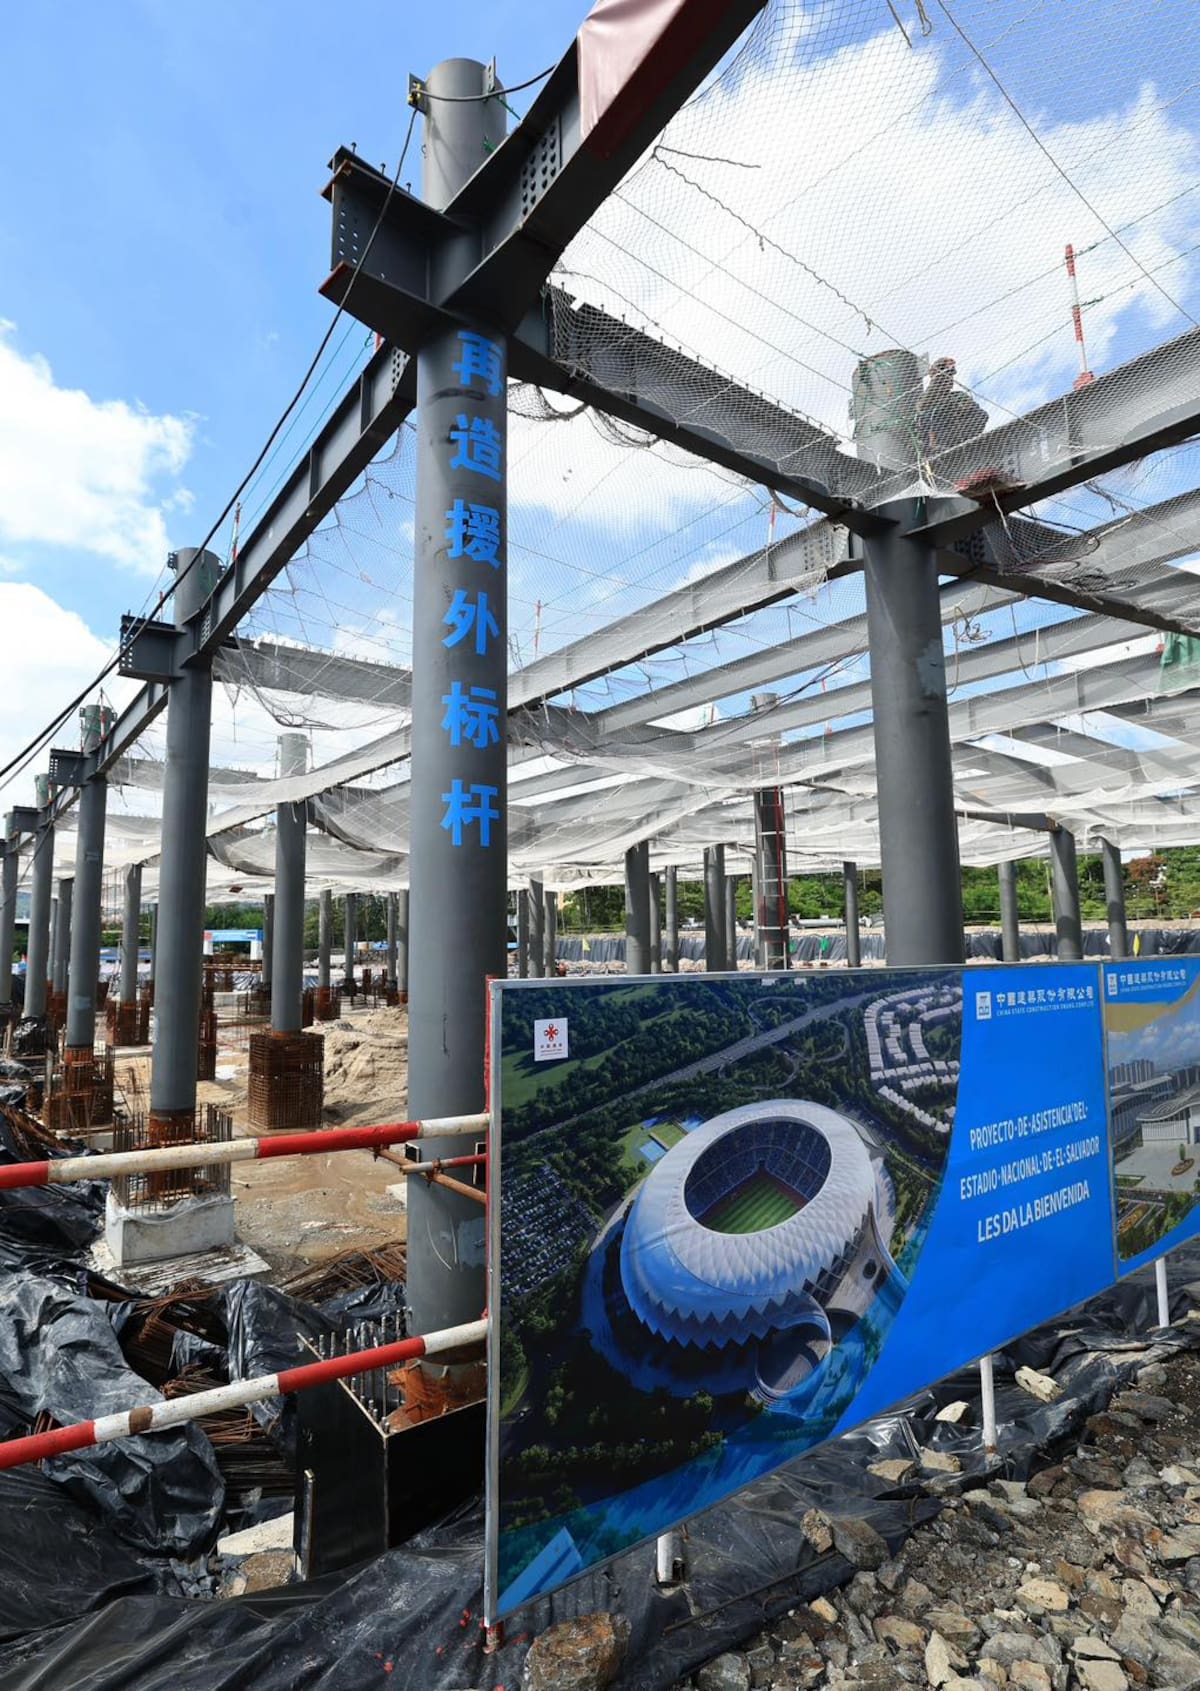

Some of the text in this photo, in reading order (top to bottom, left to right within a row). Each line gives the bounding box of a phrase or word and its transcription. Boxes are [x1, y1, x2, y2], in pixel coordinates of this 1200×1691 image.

[441, 331, 504, 847] 再造援外标杆
[970, 1120, 1014, 1151] PROYECTO
[1018, 1116, 1028, 1137] DE
[1031, 1104, 1073, 1133] ASISTENCIA
[960, 1135, 1100, 1200] ESTADIO NACIONAL DE EL SALVADOR
[978, 1180, 1090, 1242] LES DA LA BIENVENIDA
